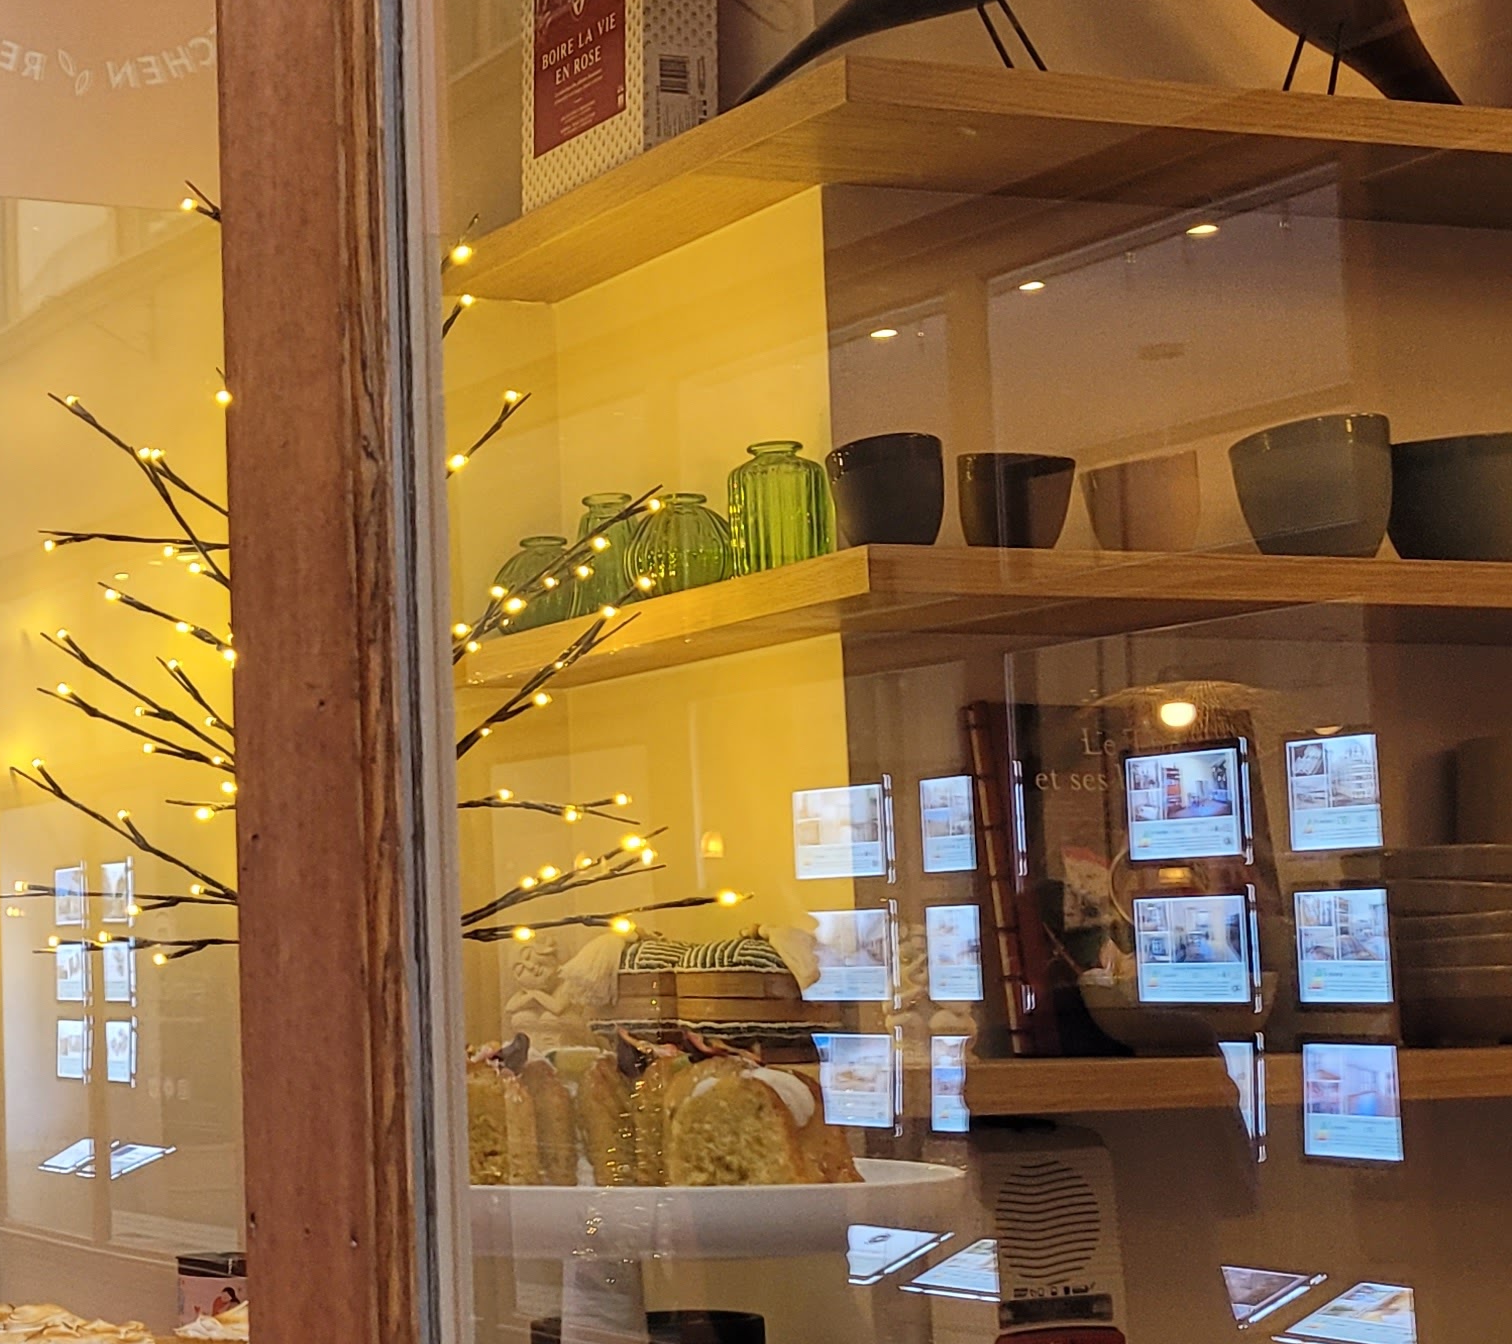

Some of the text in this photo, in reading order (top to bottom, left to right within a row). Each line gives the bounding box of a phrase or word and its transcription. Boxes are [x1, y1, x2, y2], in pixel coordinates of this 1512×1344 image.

[541, 12, 617, 71] BOIRE LA VIE
[555, 45, 602, 86] EN ROSE
[1035, 769, 1060, 791] et
[1070, 772, 1109, 792] ses
